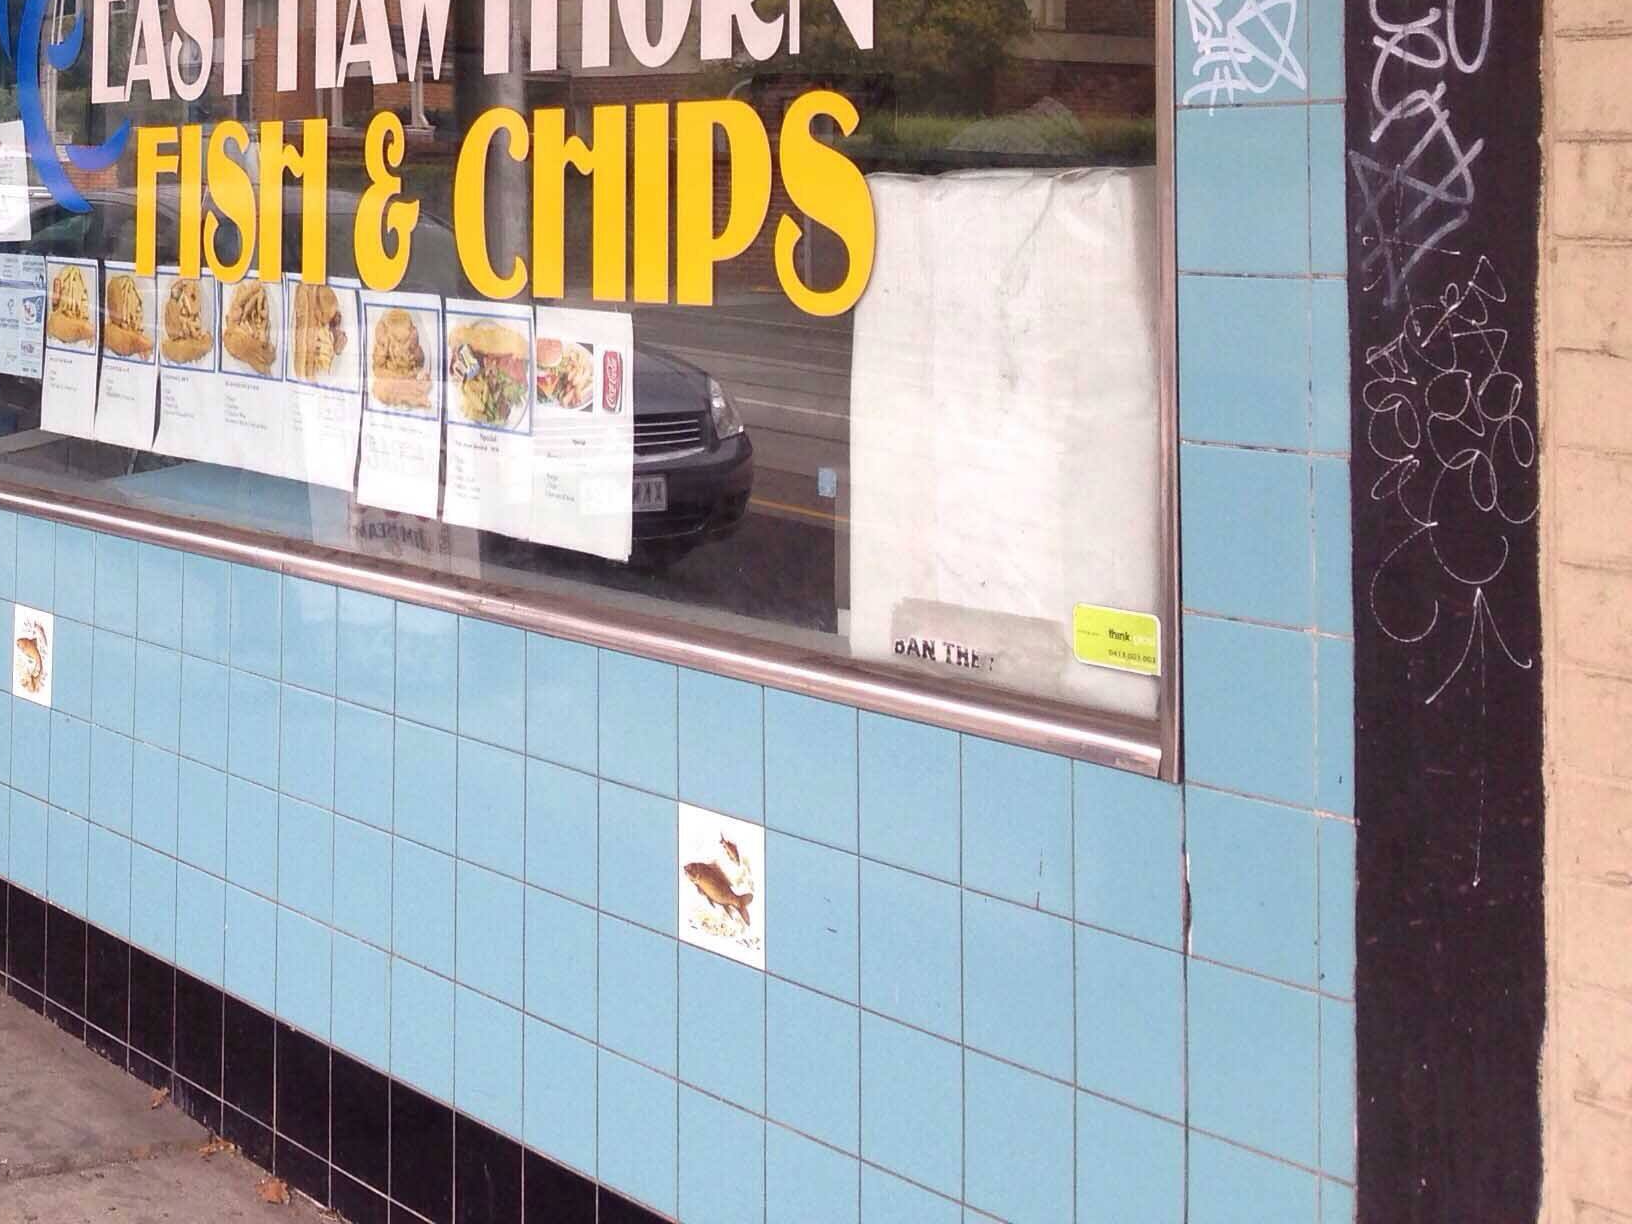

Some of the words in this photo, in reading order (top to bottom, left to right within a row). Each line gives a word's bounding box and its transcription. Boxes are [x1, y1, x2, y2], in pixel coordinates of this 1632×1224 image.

[134, 118, 328, 283] FISH
[354, 111, 419, 291] &
[453, 89, 877, 316] CHIPS
